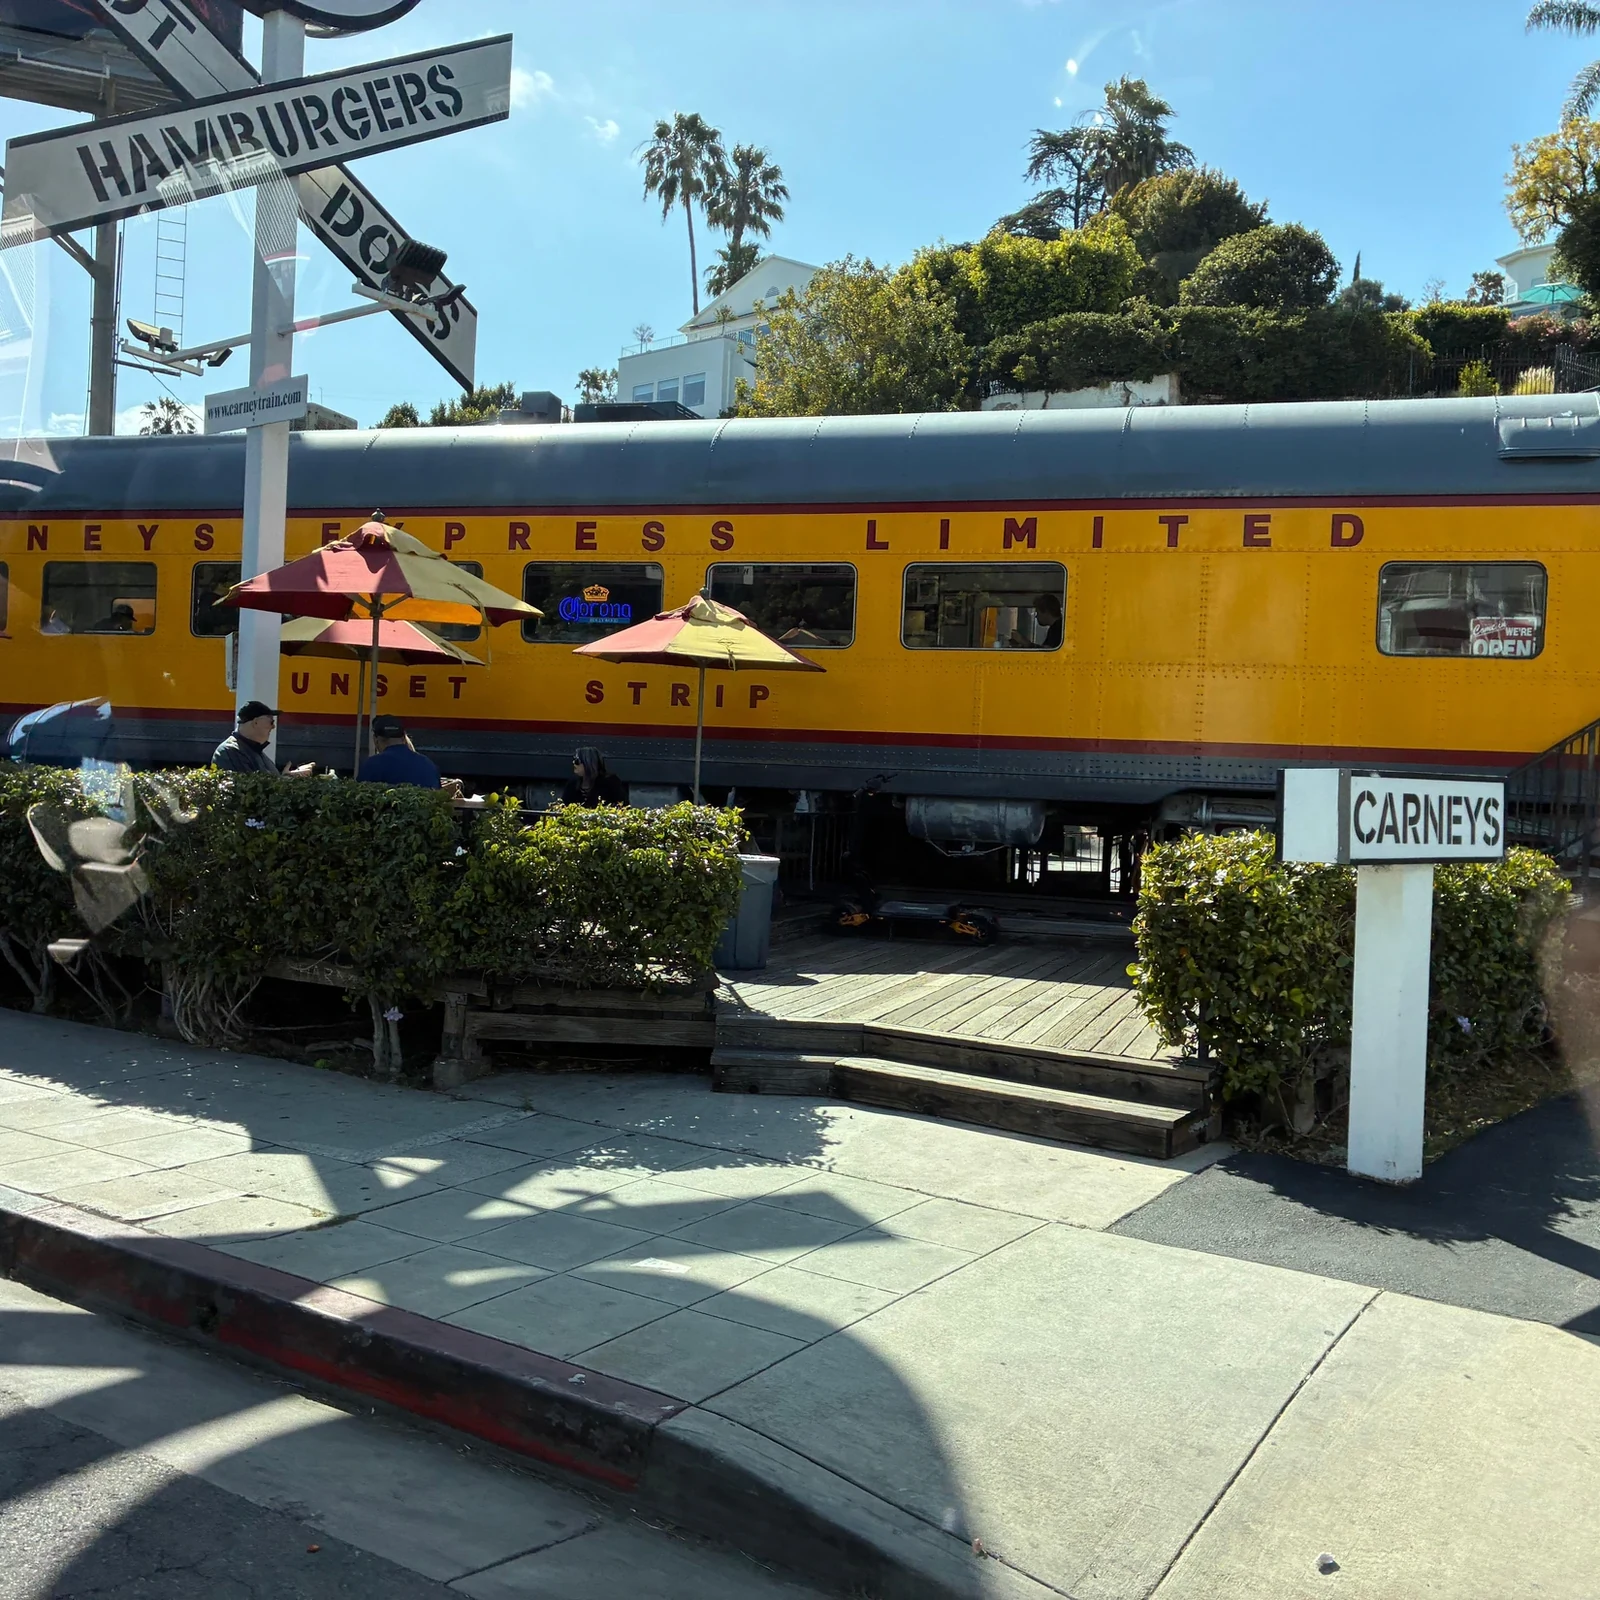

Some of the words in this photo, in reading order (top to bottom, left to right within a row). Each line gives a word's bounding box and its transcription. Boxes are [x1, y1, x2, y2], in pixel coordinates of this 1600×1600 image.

[76, 64, 464, 203] HAMBURGERS
[320, 182, 460, 341] DOS
[207, 391, 301, 420] www.carneytrain.com
[322, 520, 734, 552] EPRESS
[866, 513, 1365, 551] LIMITED
[559, 596, 632, 622] Corona
[1472, 638, 1532, 656] OPEN
[1505, 626, 1533, 637] WE'RE
[291, 672, 467, 699] UNSET
[585, 679, 770, 709] STRIP
[1353, 789, 1501, 847] CARNEYS
